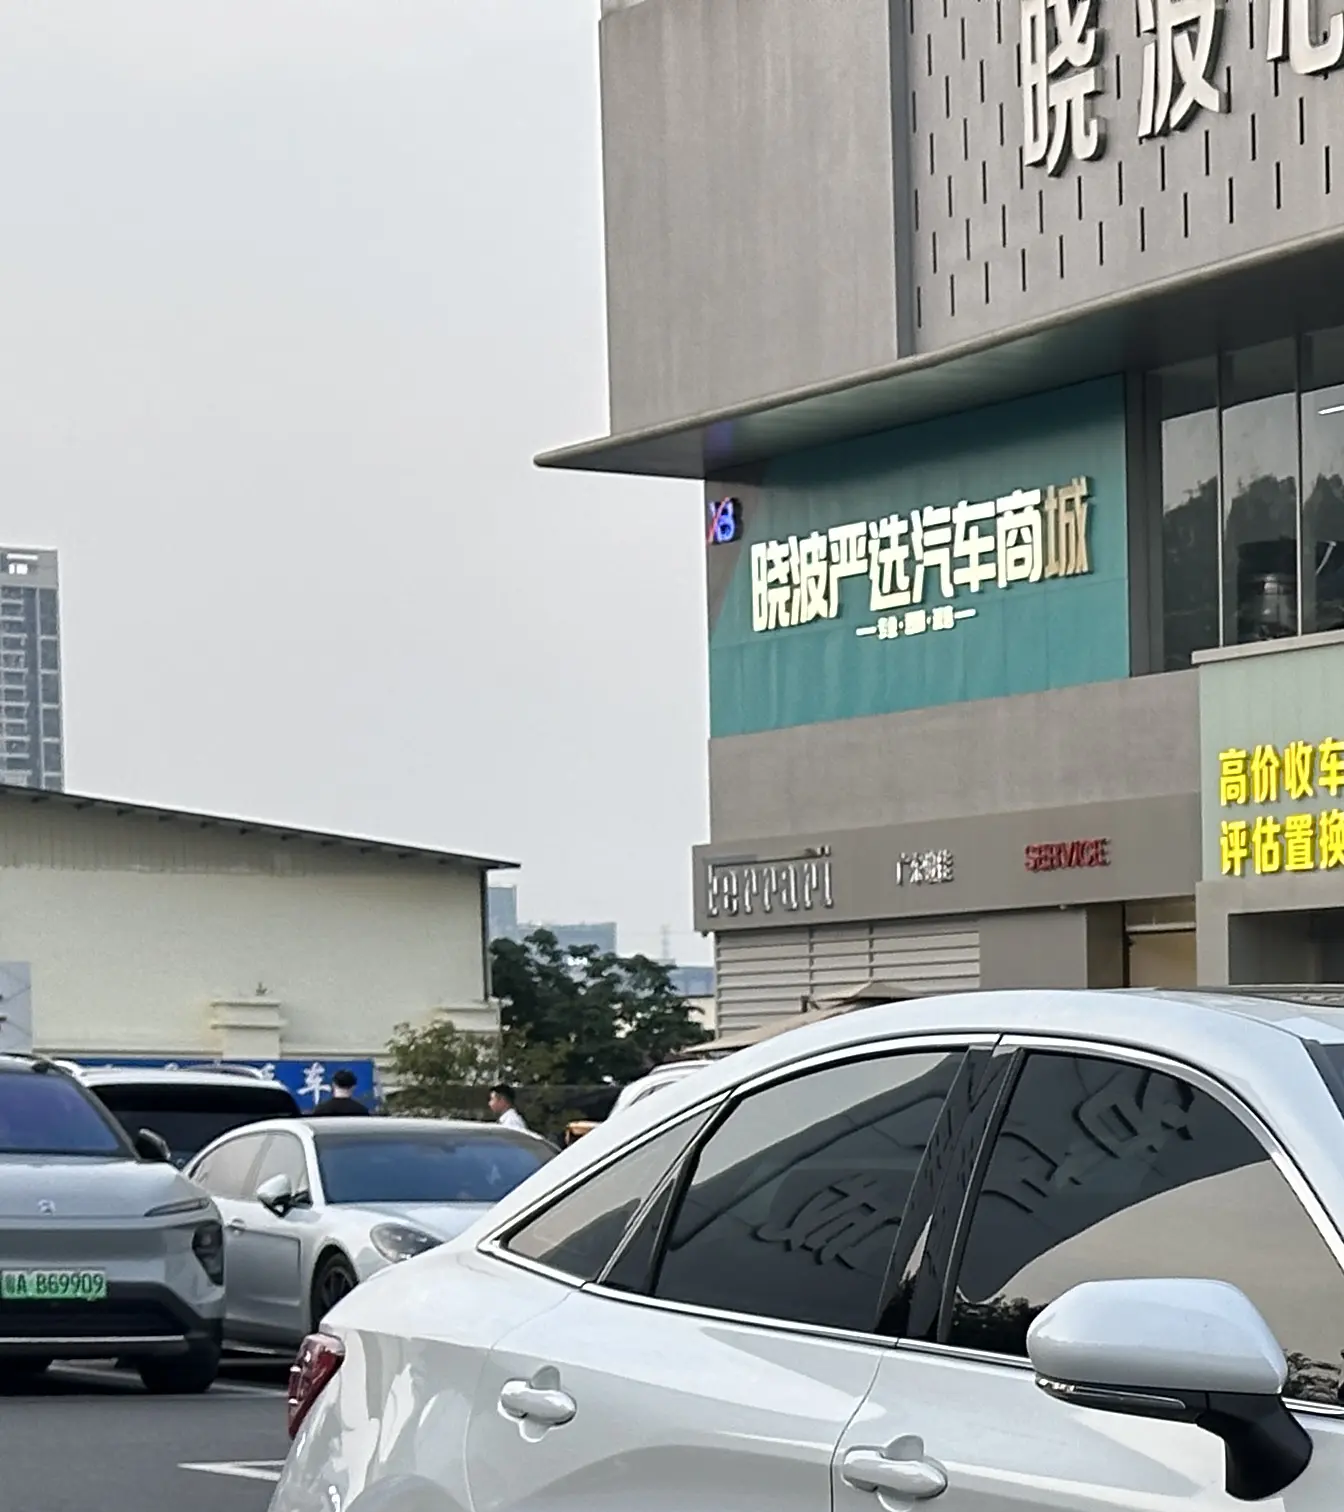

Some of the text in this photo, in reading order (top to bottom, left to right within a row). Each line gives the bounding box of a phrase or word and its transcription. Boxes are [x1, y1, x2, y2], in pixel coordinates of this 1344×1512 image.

[751, 476, 1093, 632] 晓波严选汽车商城
[1025, 838, 1111, 872] SERVICE
